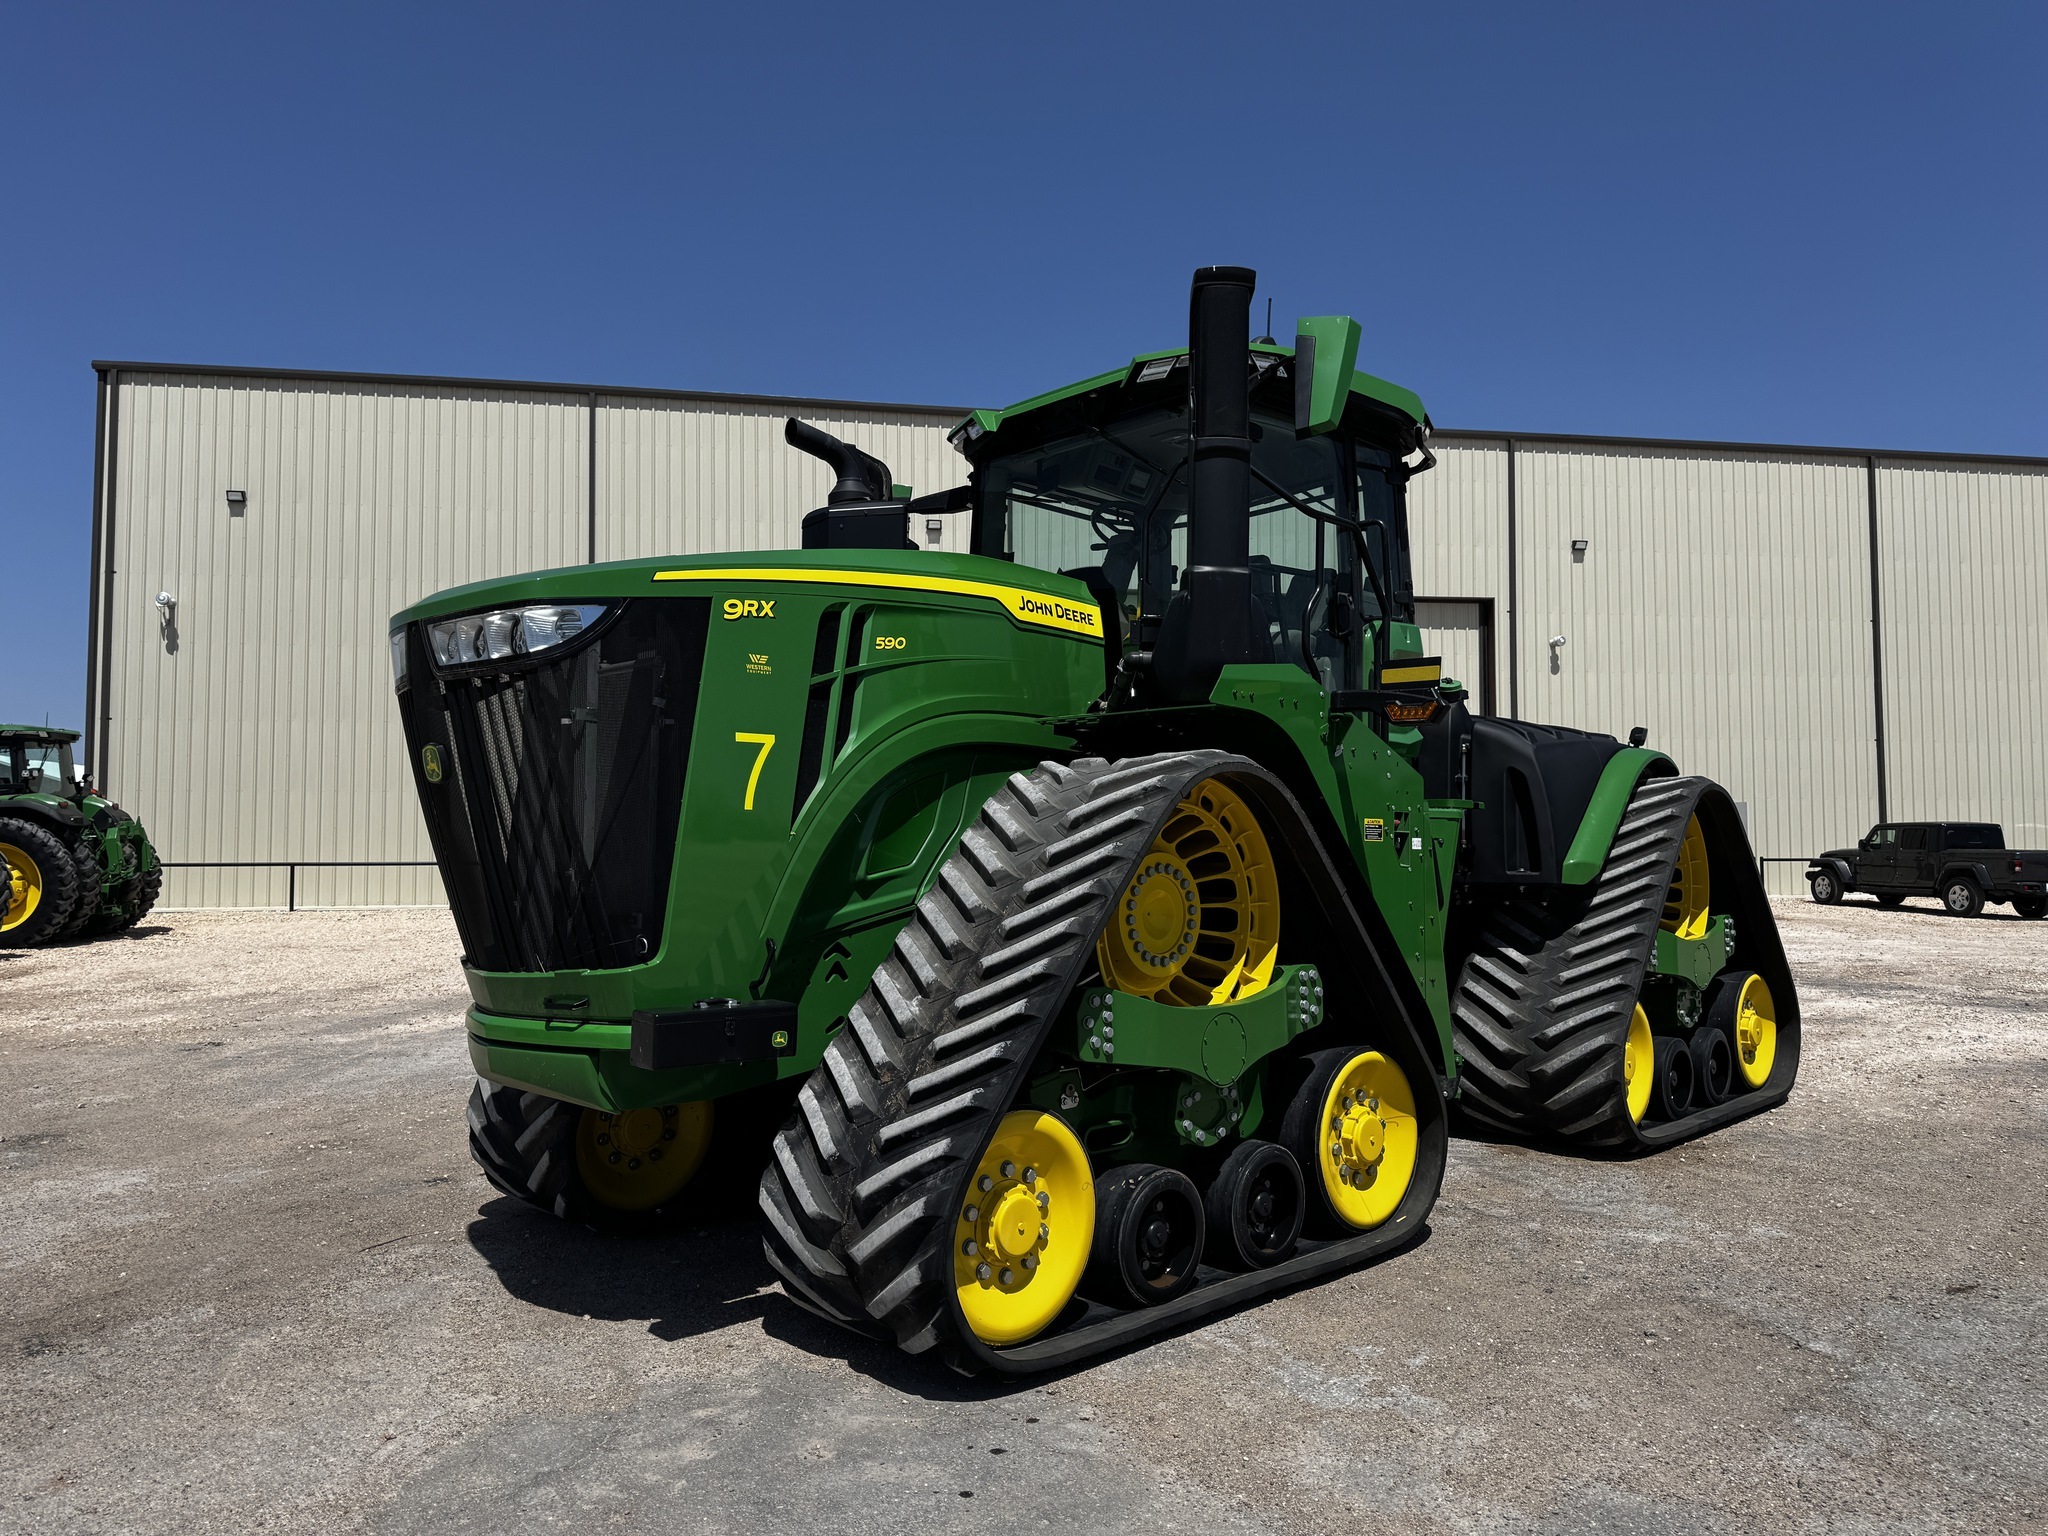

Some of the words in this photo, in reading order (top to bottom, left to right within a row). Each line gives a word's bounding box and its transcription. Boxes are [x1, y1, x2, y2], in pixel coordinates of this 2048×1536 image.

[723, 599, 776, 620] 9RX
[1019, 595, 1053, 617] JOHN
[1055, 603, 1095, 626] DEERE
[875, 636, 906, 650] 590
[735, 731, 776, 810] 7
